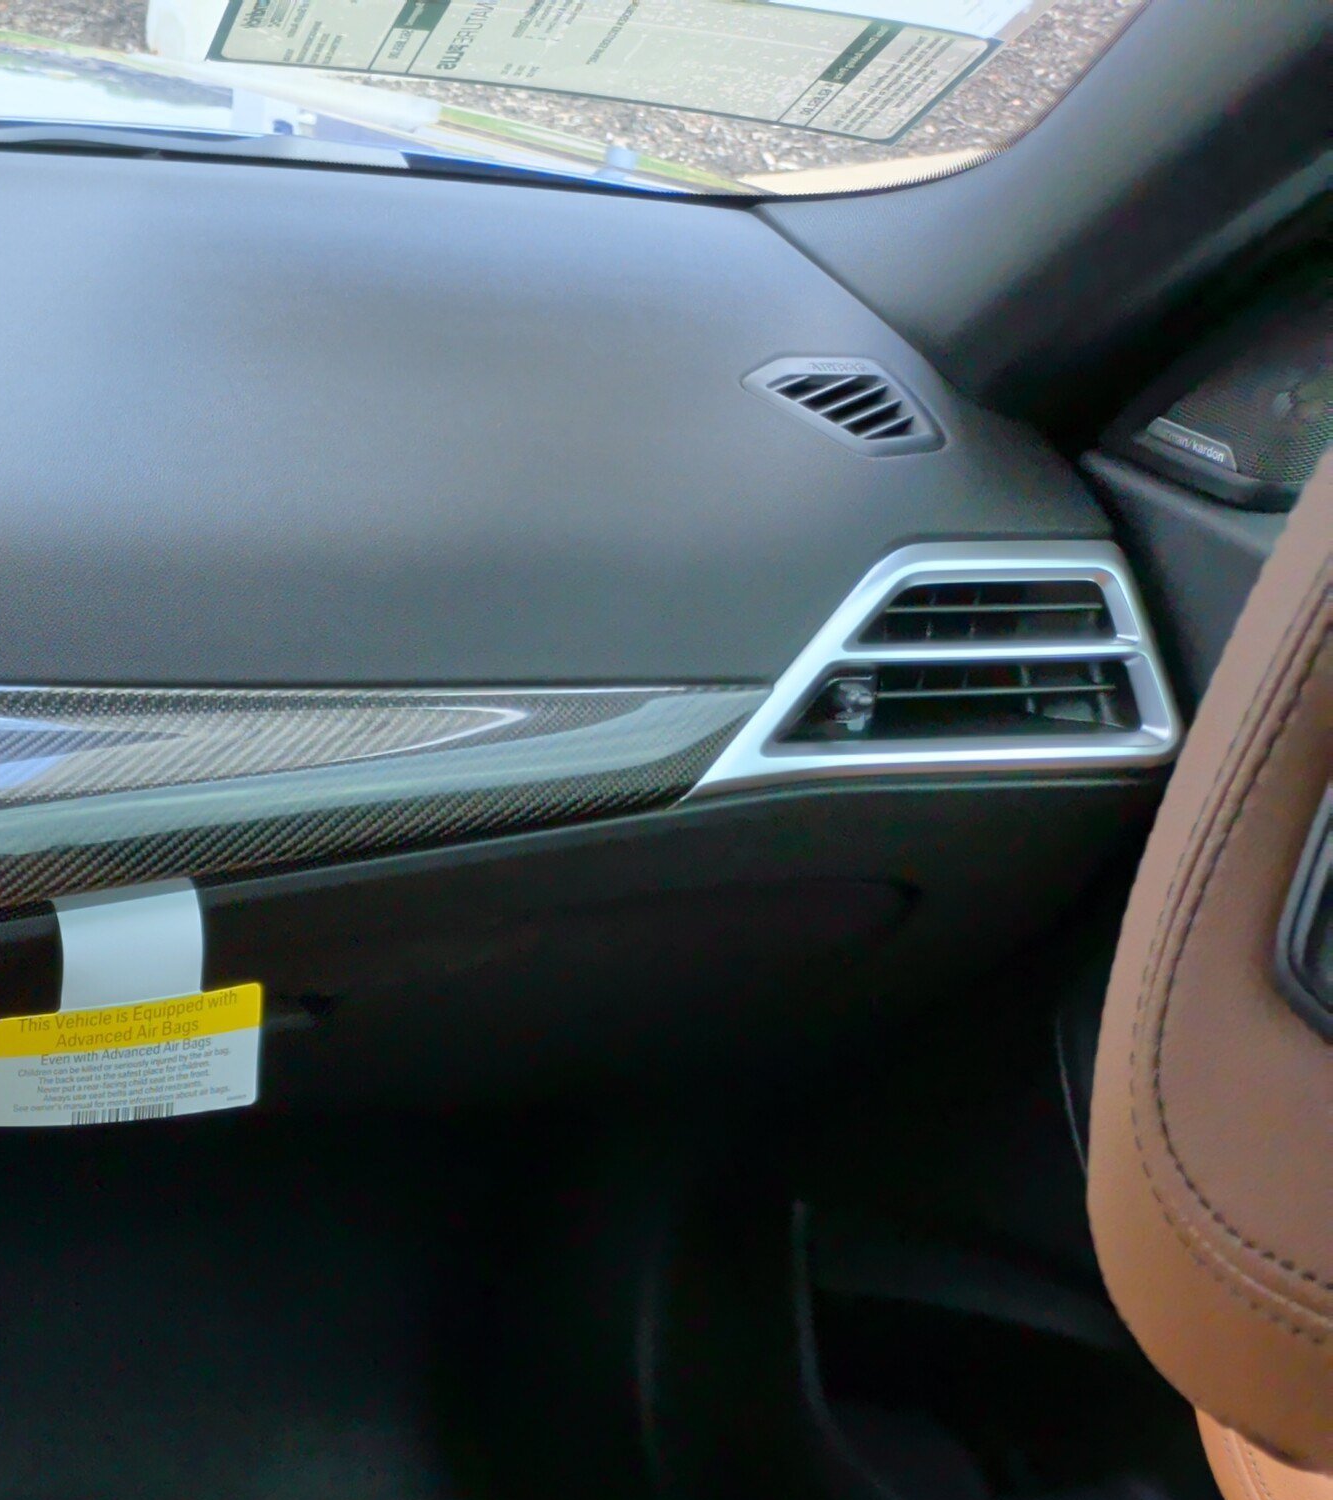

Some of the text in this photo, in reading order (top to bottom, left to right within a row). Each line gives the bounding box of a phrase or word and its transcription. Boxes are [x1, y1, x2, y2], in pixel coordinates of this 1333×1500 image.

[19, 990, 237, 1033] This Vehicle is Equipped with
[55, 1020, 199, 1048] Advanced Air Bags
[41, 1037, 212, 1066] Even with Advanced Air Bags
[18, 1068, 52, 1077] Children
[53, 1067, 69, 1075] can
[69, 1066, 80, 1074] be
